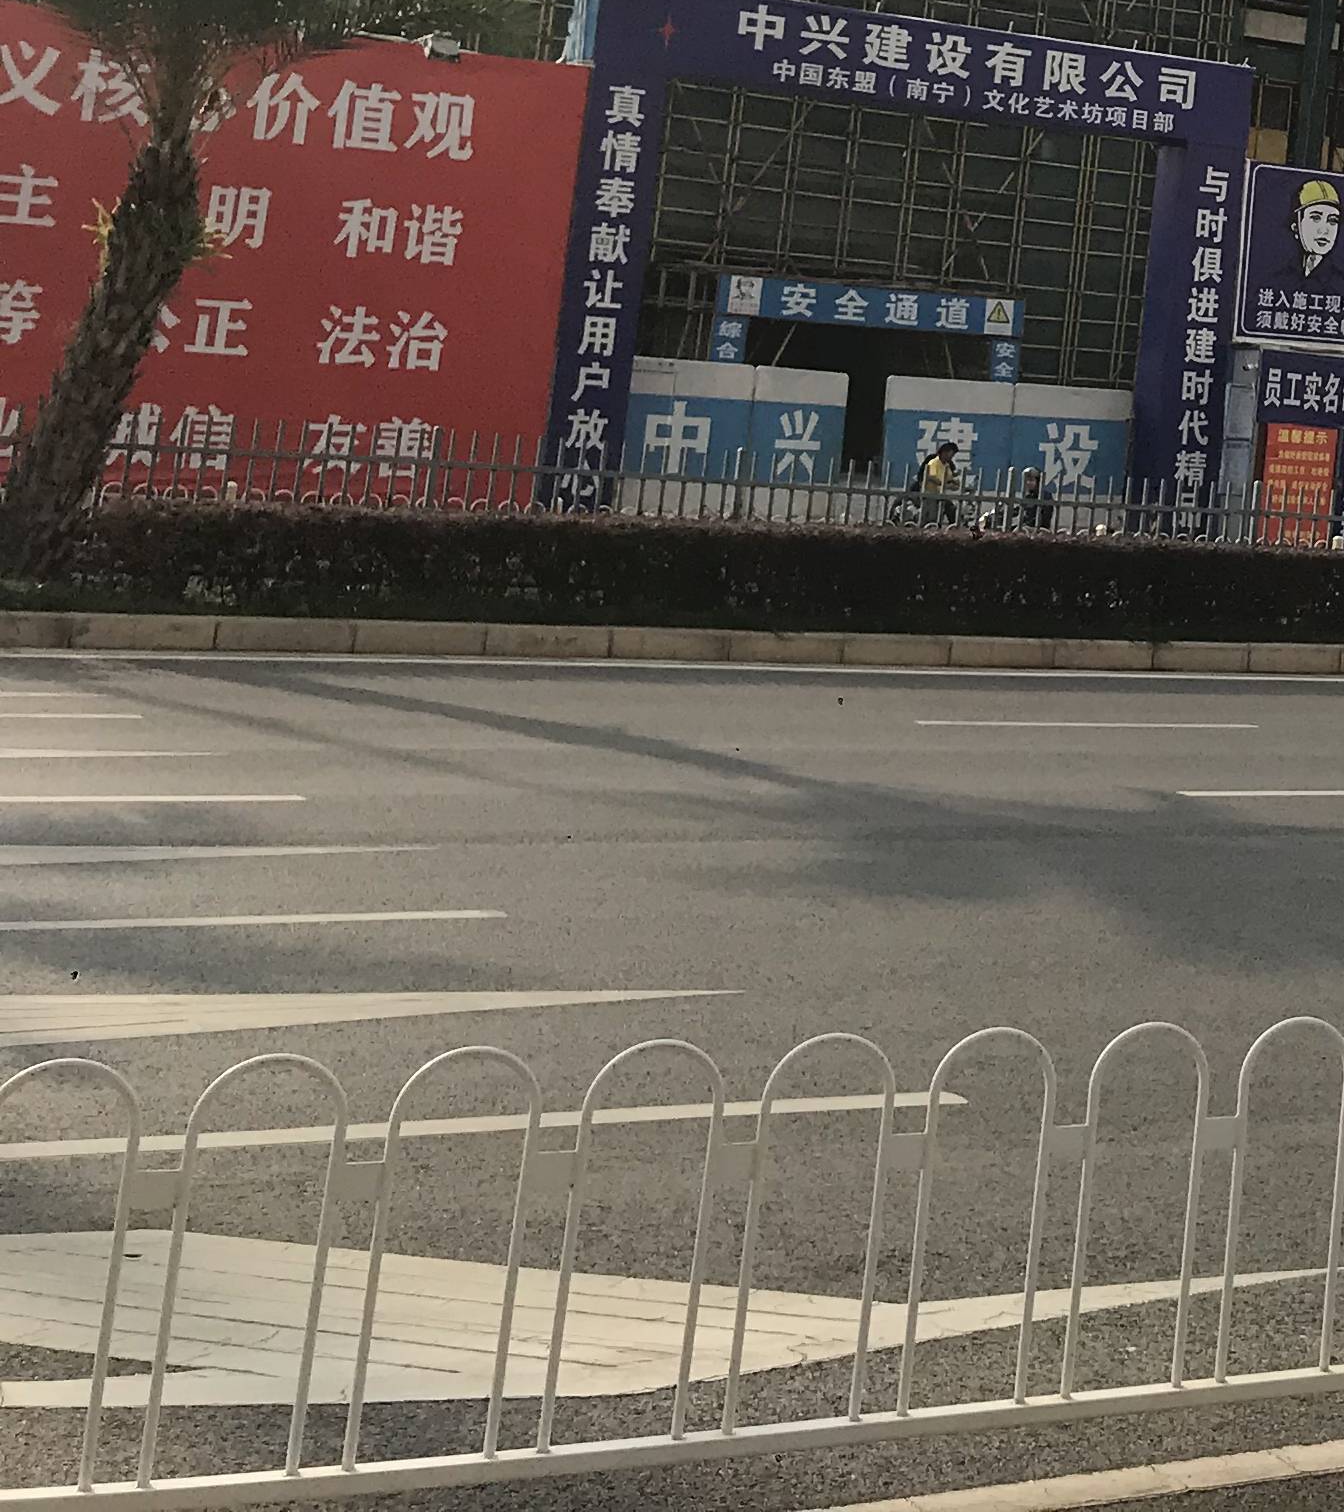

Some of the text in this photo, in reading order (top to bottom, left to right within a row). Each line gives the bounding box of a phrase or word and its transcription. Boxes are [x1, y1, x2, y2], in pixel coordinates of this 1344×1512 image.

[738, 4, 1197, 110] 中兴建设有限公司
[0, 40, 474, 162] 义核价值观
[334, 196, 465, 267] 和谐
[562, 85, 646, 497] 真情奉献让用户放心
[781, 283, 971, 330] 安全通道
[315, 305, 449, 372] 法治
[995, 341, 1017, 379] 安全
[1174, 165, 1230, 528] 与时俱进建时代精品
[302, 413, 432, 479] 友善
